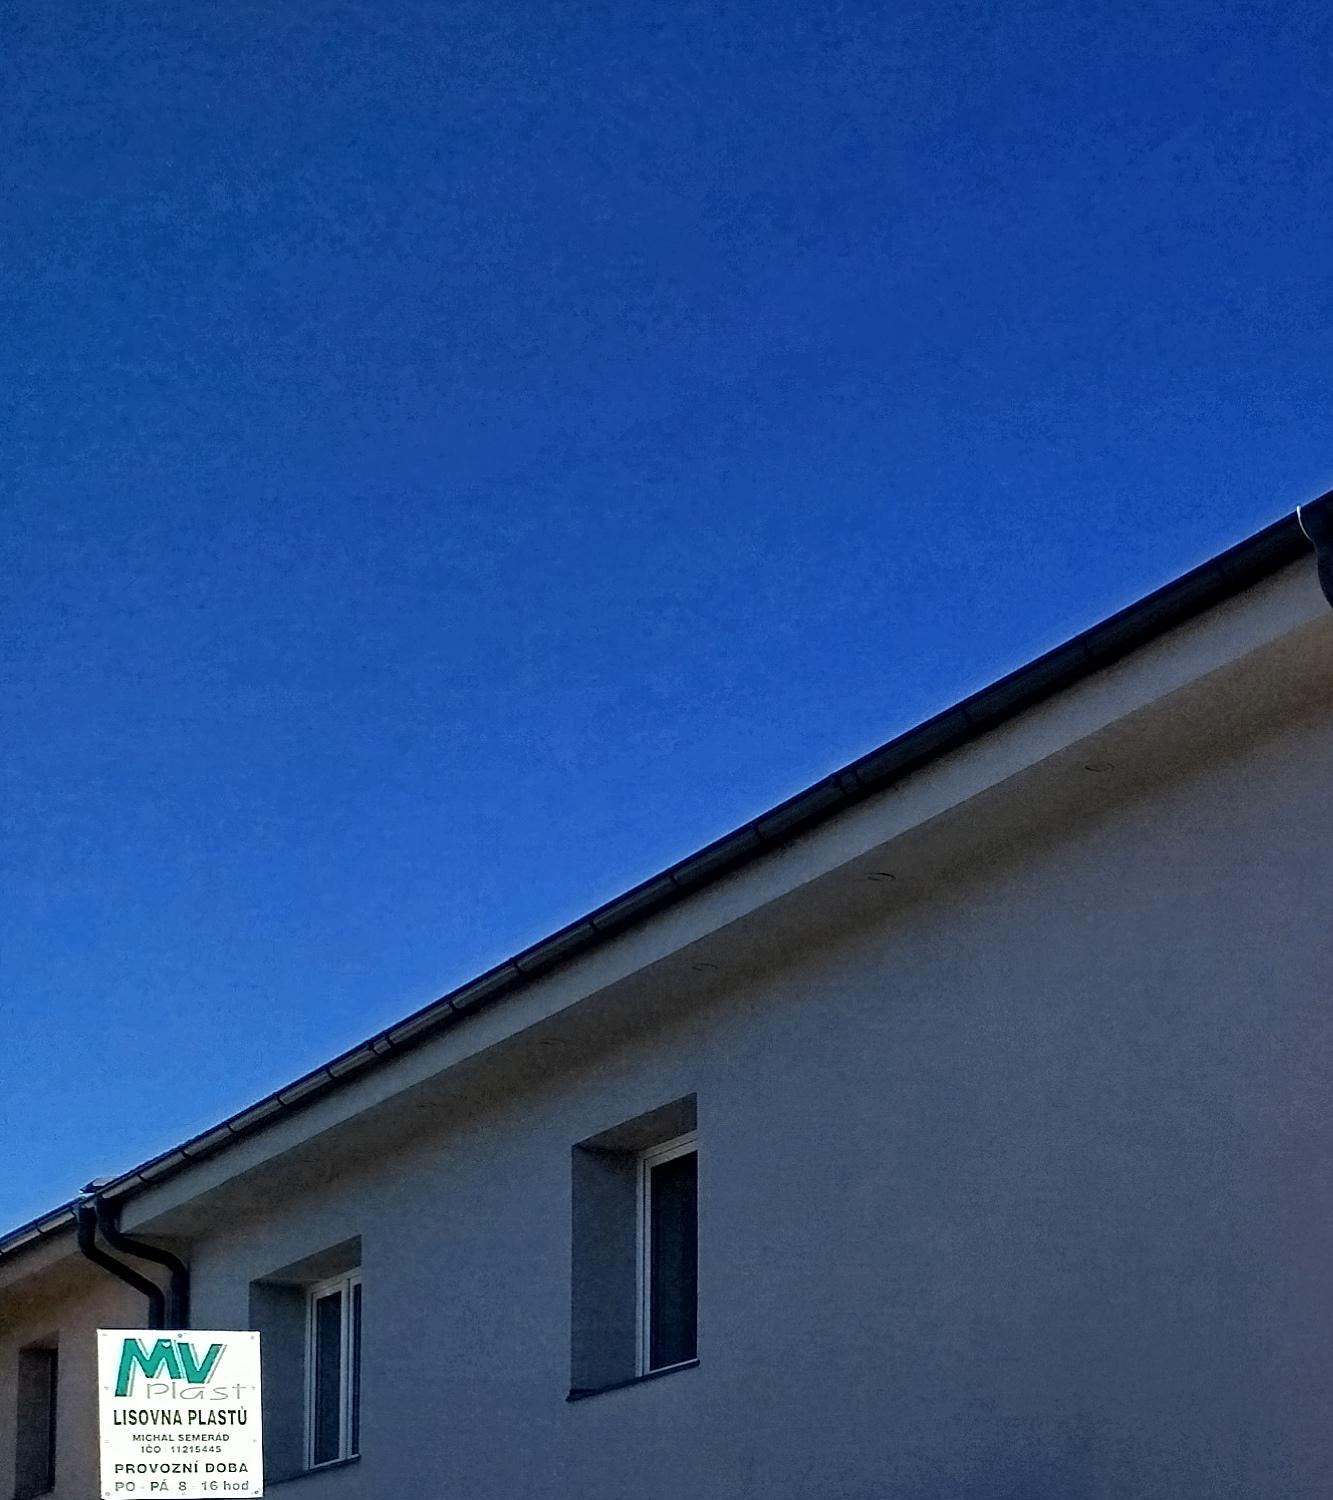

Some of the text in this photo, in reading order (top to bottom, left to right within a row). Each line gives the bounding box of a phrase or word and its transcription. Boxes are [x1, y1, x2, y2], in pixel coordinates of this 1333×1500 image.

[114, 1337, 228, 1398] MV
[113, 1409, 183, 1426] LISOVNA
[132, 1432, 230, 1442] MICHAL SEMERÁD
[114, 1460, 248, 1474] PROVOZNÍ DOBA
[115, 1481, 136, 1492] PO
[150, 1479, 169, 1492] PÁ
[201, 1480, 218, 1491] 16
[223, 1480, 249, 1491] hod
